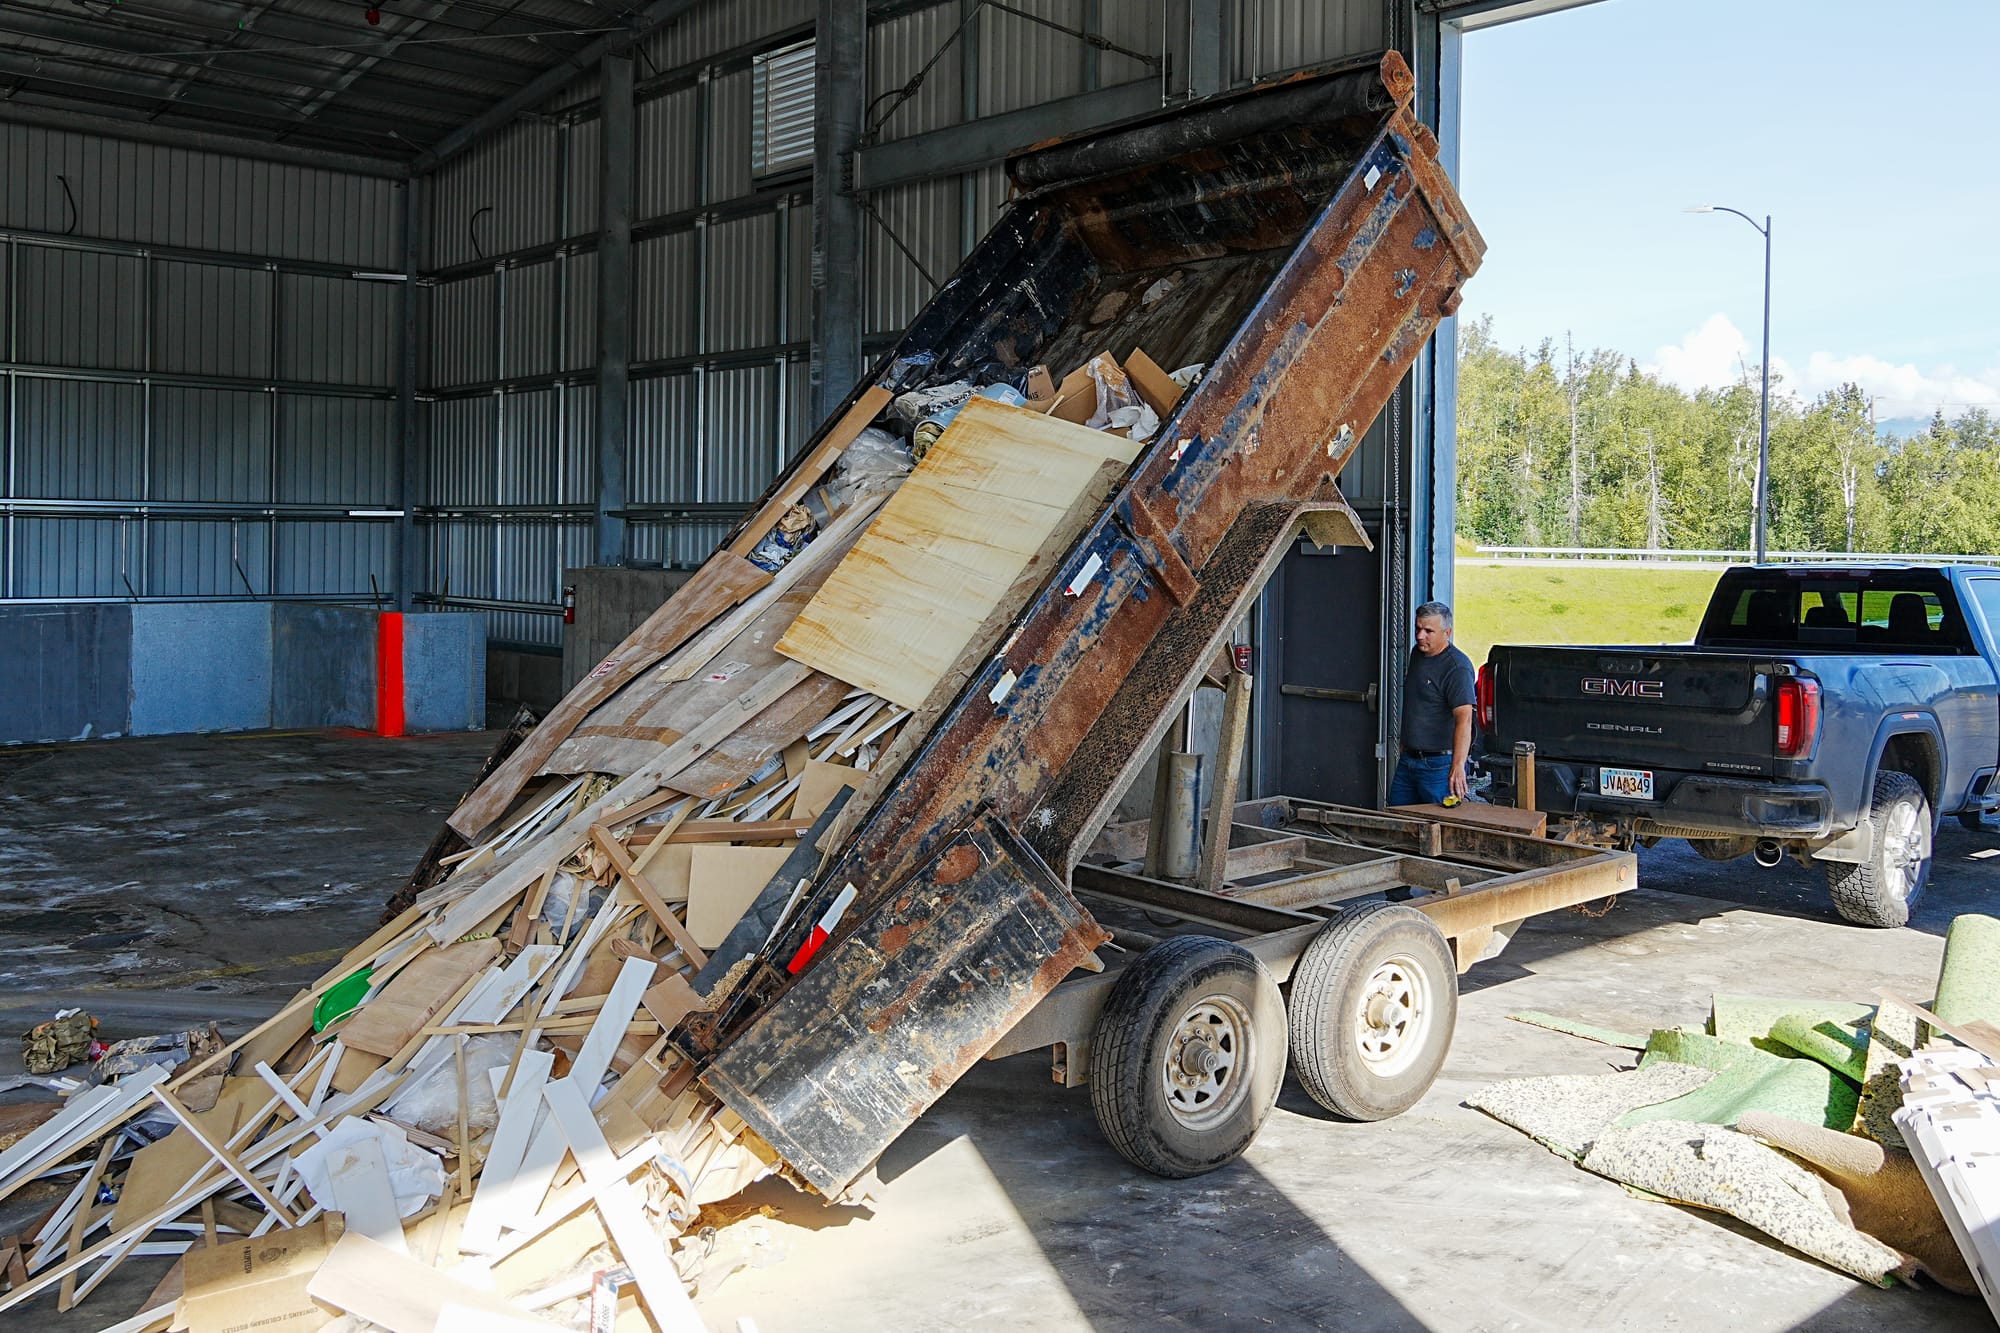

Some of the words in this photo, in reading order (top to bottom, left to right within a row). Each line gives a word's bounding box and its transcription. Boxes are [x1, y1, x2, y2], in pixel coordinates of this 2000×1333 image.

[1581, 677, 1663, 698] GMC
[1586, 722, 1662, 734] DENALI
[1706, 761, 1761, 771] SIERRA
